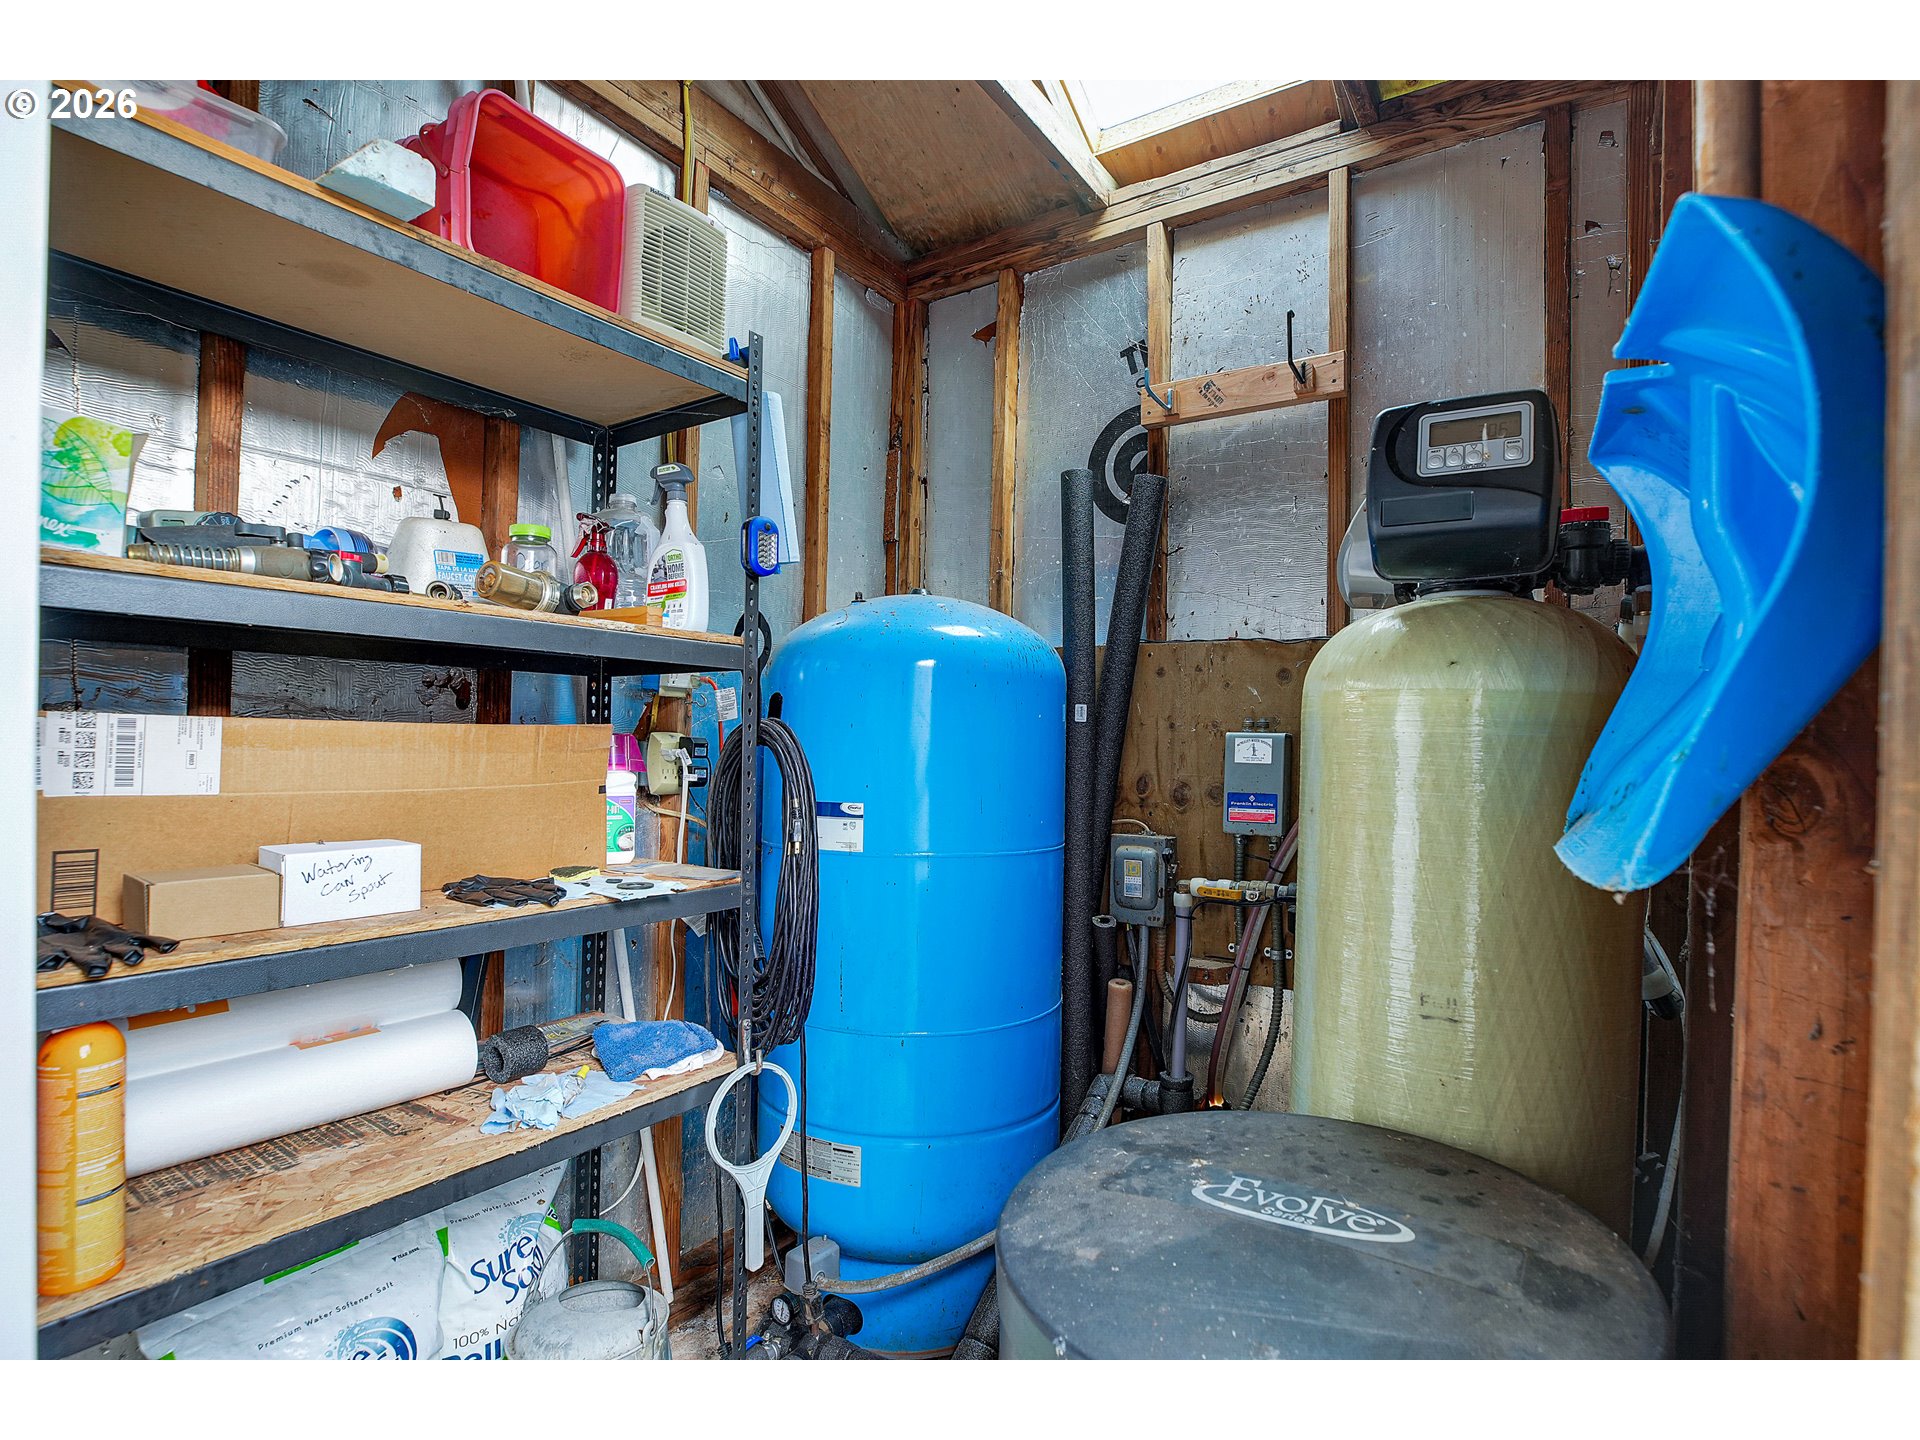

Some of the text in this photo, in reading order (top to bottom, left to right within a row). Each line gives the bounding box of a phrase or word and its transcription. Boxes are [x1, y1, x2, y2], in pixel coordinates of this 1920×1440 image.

[438, 571, 462, 581] FAUCET
[667, 563, 684, 573] HOME
[301, 853, 373, 884] Watering
[348, 871, 393, 903] Spout
[450, 1188, 545, 1225] Premium Water Softener Salt
[1217, 1175, 1379, 1233] Evolve
[1260, 1206, 1316, 1226] Series
[470, 1235, 533, 1294] Sure
[257, 1281, 394, 1351] Premium Water Softener Salt
[453, 1328, 490, 1349] 100%
